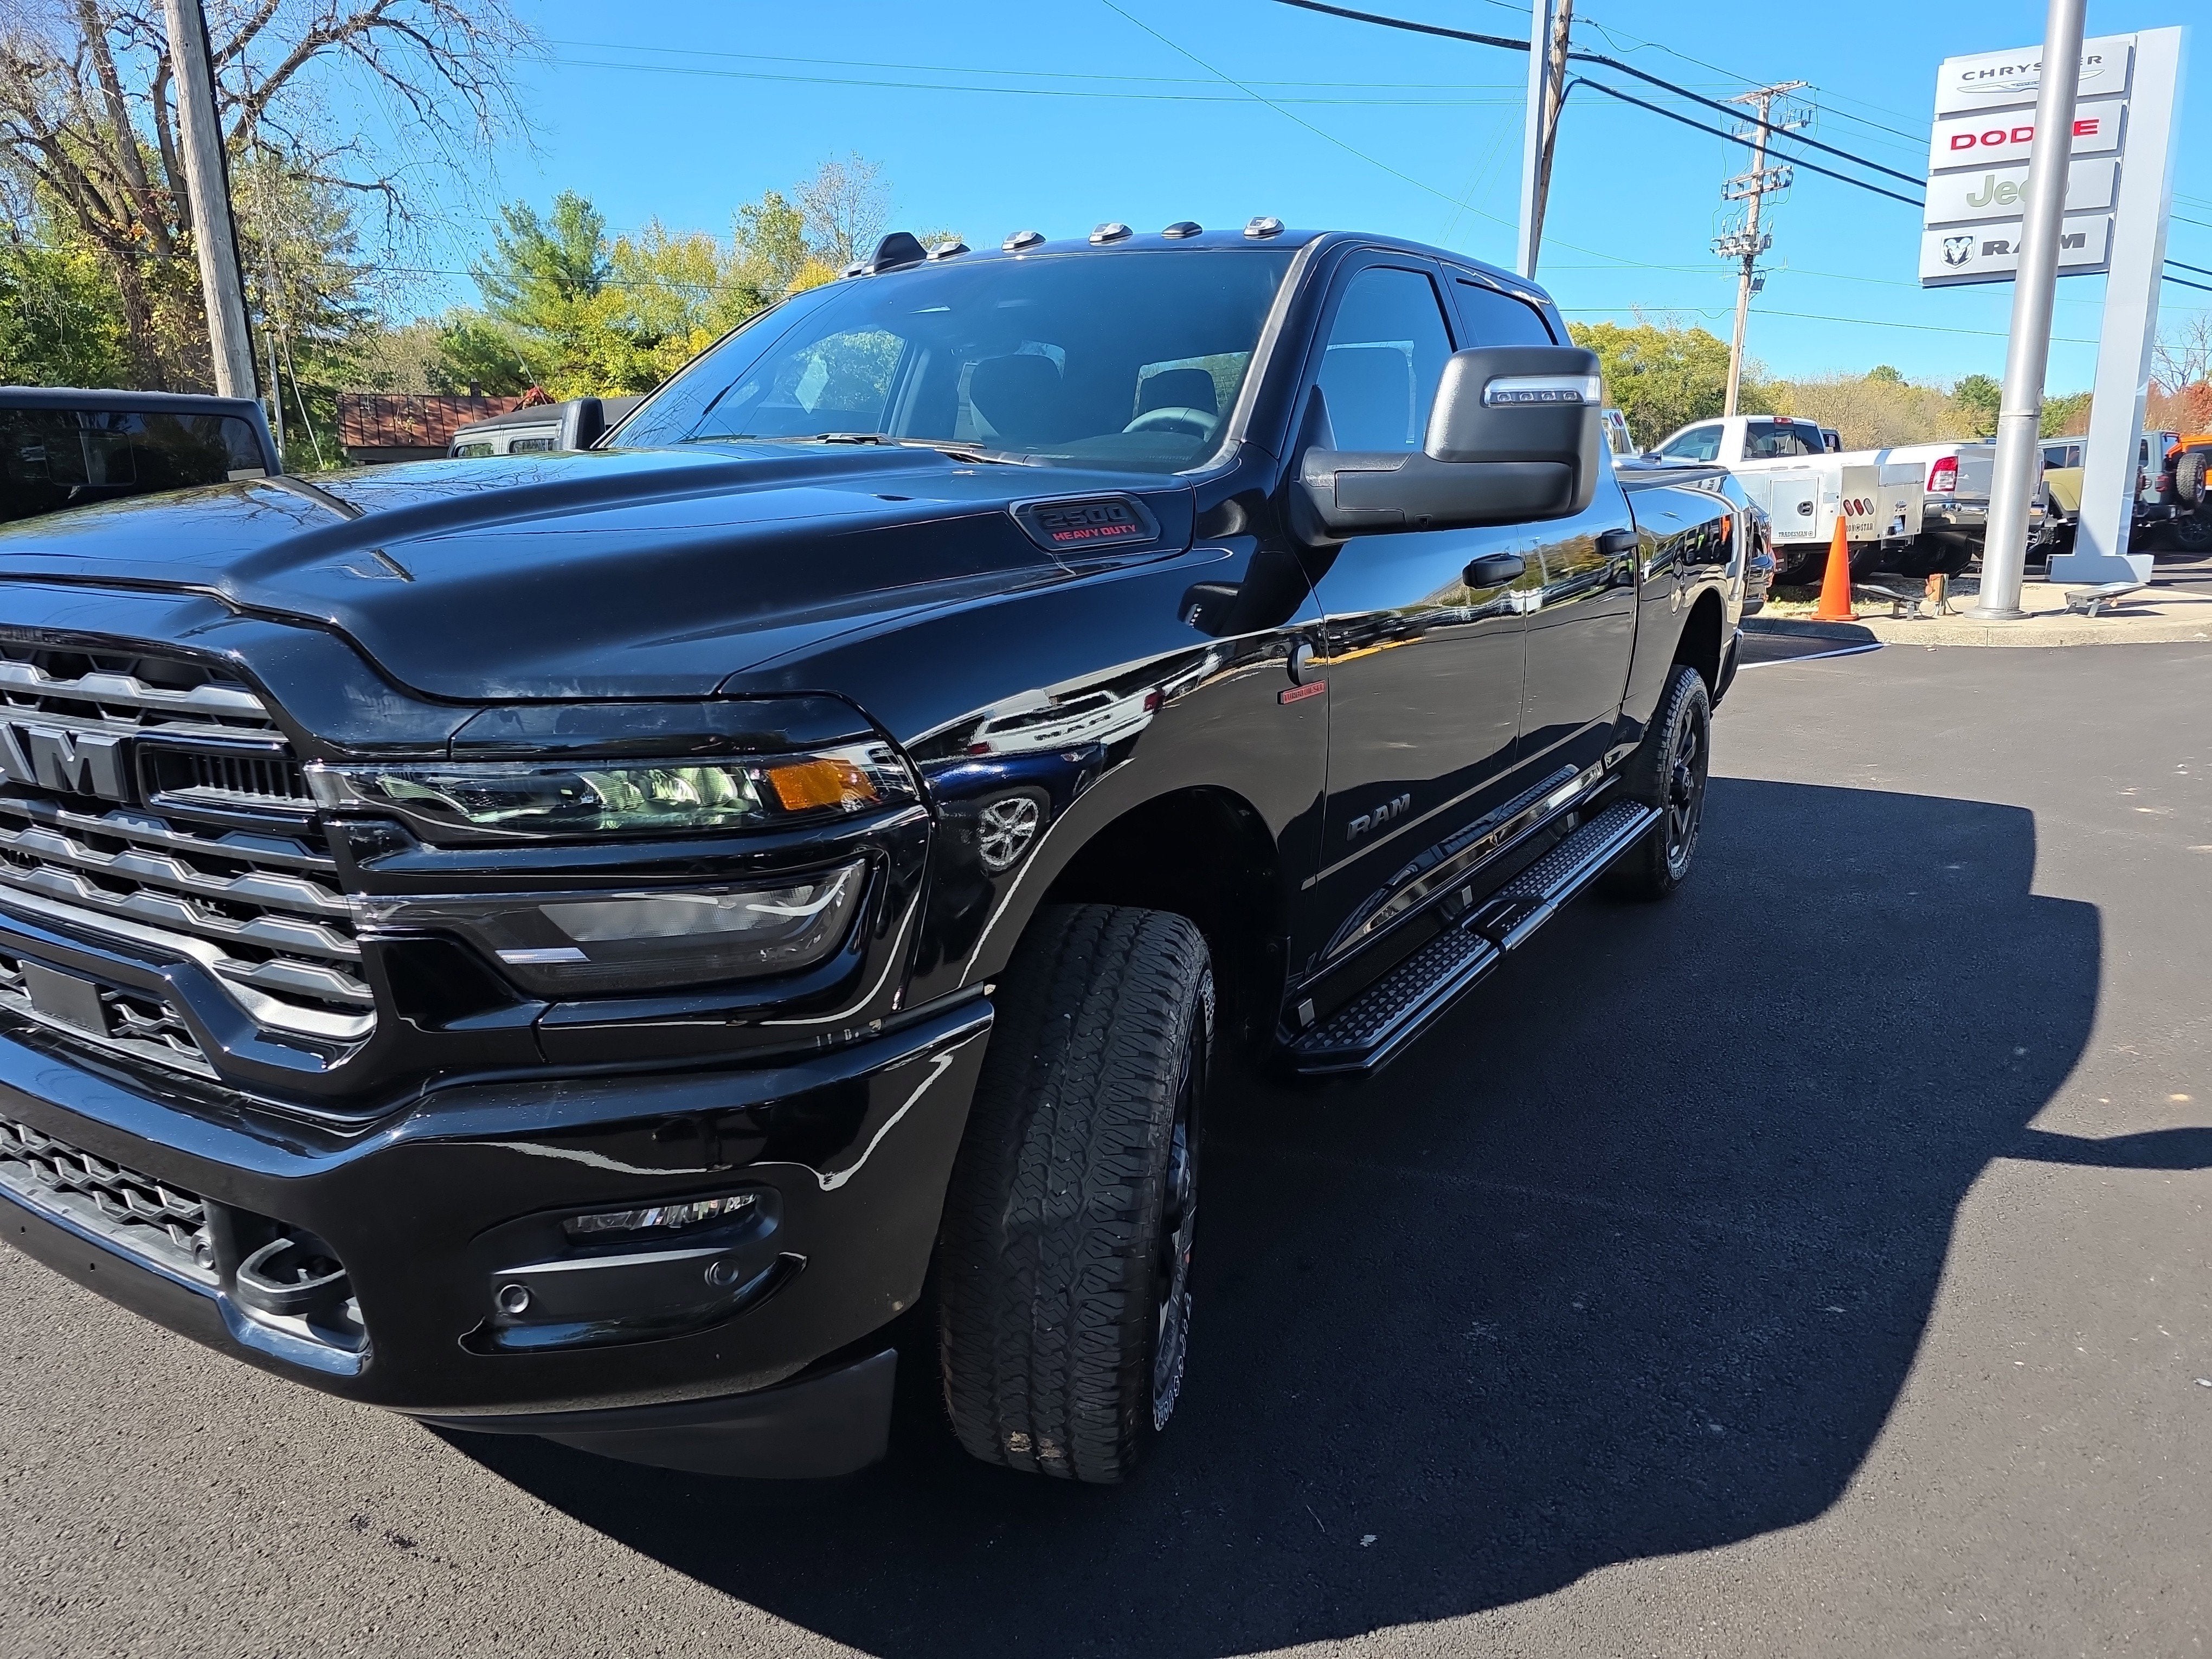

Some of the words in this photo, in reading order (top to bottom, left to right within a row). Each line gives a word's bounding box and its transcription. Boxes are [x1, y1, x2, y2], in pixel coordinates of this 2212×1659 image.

[1962, 55, 2102, 80] CHRYSR
[1951, 119, 2099, 150] DODE
[1966, 175, 2070, 208] Je
[1981, 233, 2086, 256] RM
[1039, 507, 1128, 529] 2500
[1861, 523, 1873, 531] STAR
[1052, 529, 1099, 541] HEAVY
[1099, 524, 1136, 536] DUTY
[1346, 793, 1410, 841] RAM
